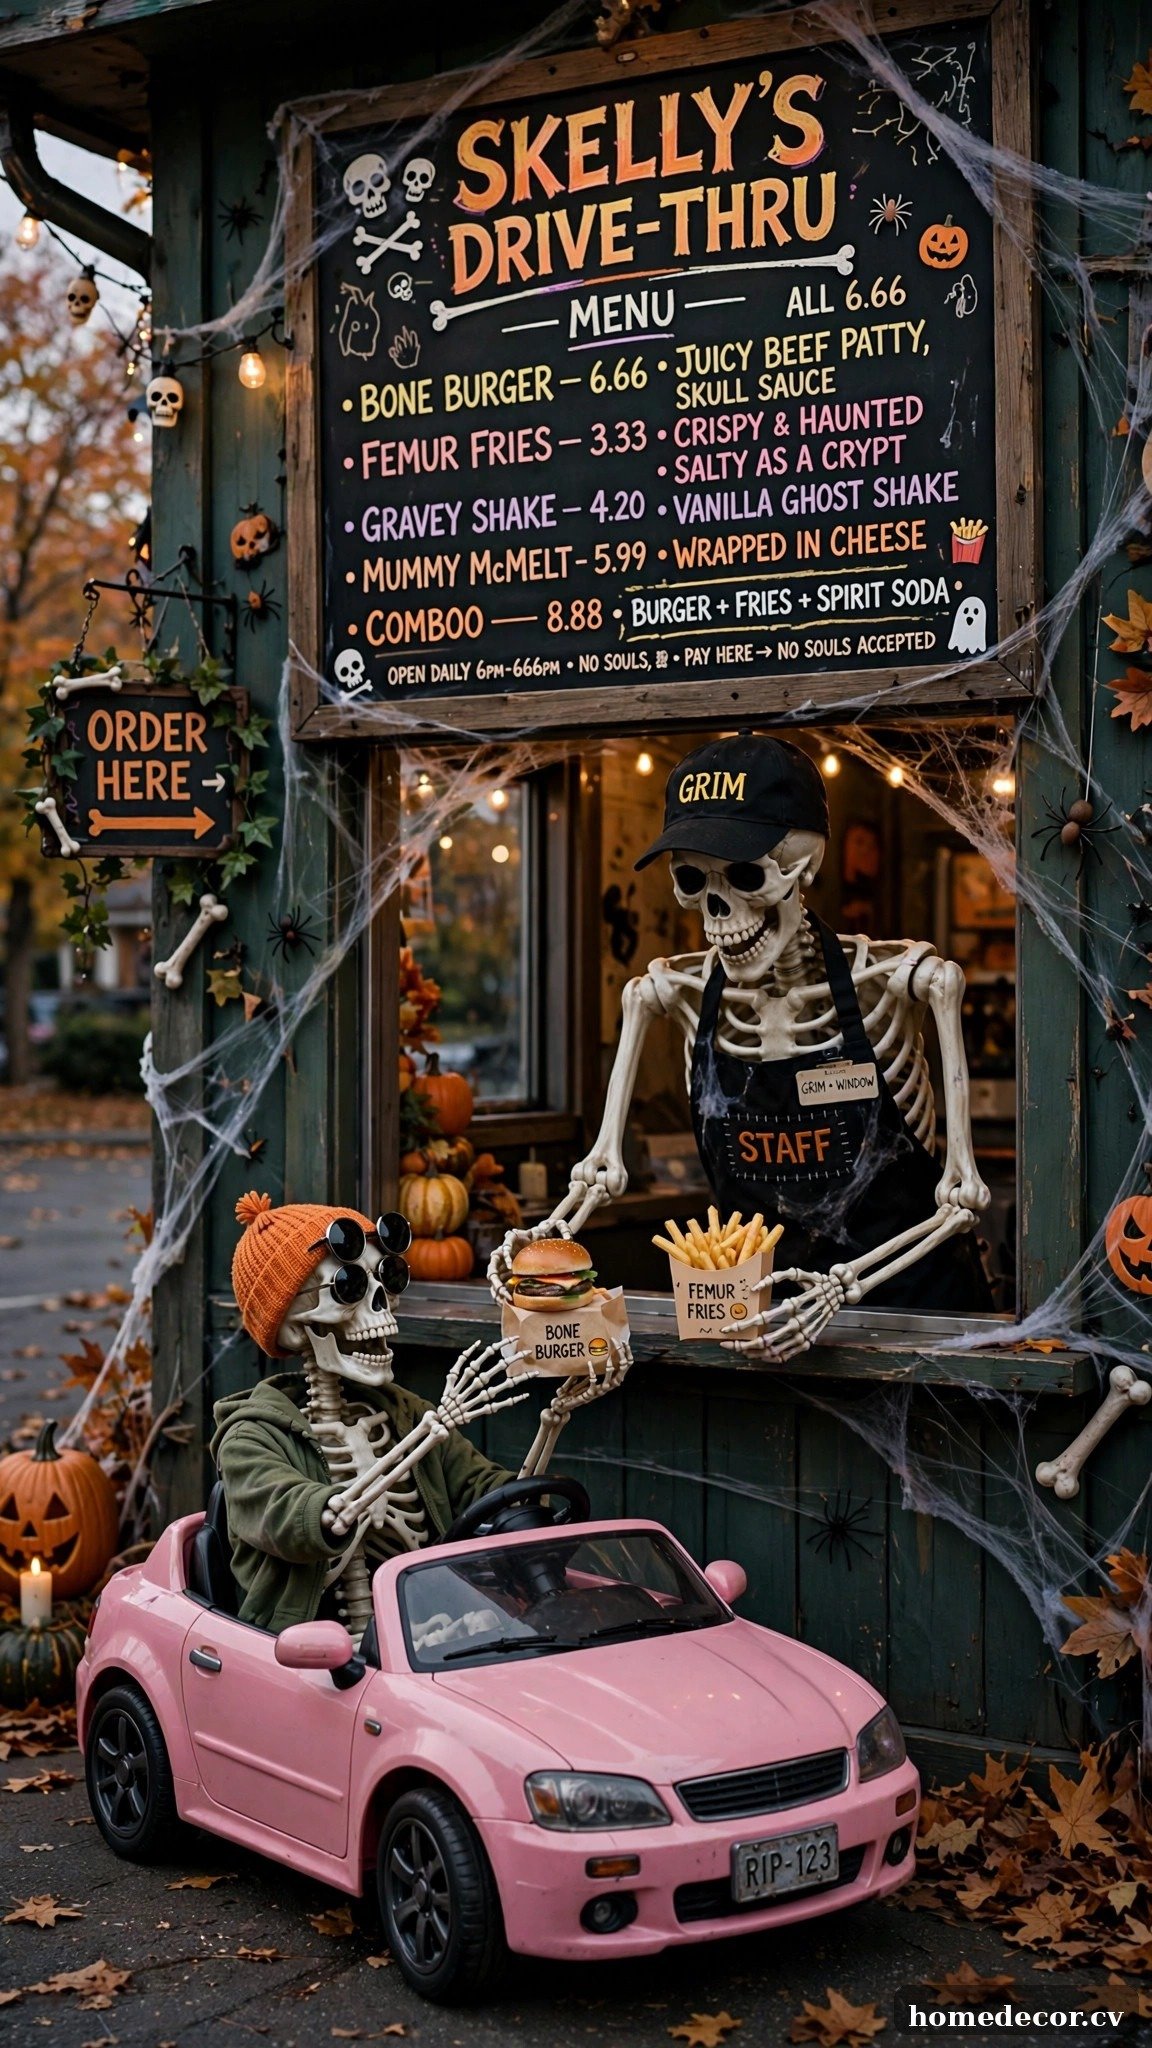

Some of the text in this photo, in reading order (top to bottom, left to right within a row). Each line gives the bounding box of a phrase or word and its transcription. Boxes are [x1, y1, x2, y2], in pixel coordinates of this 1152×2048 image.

[453, 71, 824, 214] SKELLY'S
[448, 171, 837, 295] DRIVE-THRU
[570, 289, 674, 338] MENU
[786, 275, 906, 317] ALL 6.66
[676, 319, 929, 377] JUICY BEEF PATTY,
[361, 356, 647, 422] BONE BURGER 6.66
[676, 367, 836, 409] SKULL SAUCE
[674, 396, 923, 447] CRISPY & HAUNTED
[362, 420, 647, 479] FEMUR FRIES 3.33
[675, 435, 906, 484] SALTY AS A CRYPT
[362, 490, 645, 542] GRAVEY SHAKE 4.20
[673, 471, 958, 524] VANILLA GHOST SHAKE
[364, 541, 646, 593] MUMMY McMELT 5.99
[673, 520, 926, 569] WRAPPED IN CHEESE
[366, 599, 602, 646] COMBOO 8.88
[631, 577, 950, 626] BURGER + FRIES + SPIRIT SODA
[388, 665, 425, 685] OPEN
[431, 662, 471, 682] DAILY
[579, 655, 599, 672] NO
[604, 651, 651, 671] SOULS,
[685, 647, 710, 666] PAY
[717, 644, 753, 663] HERE
[778, 641, 799, 659] NO
[805, 637, 851, 658] SOULS
[857, 631, 936, 654] ACCEPTED
[88, 710, 207, 753] ORDER
[98, 760, 190, 800] HERE
[679, 772, 747, 803] GRIM
[802, 1076, 874, 1094] GRIM WINDOW
[739, 1128, 830, 1163] STAFF
[688, 1303, 725, 1319] FRIES
[689, 1283, 735, 1299] FEMUR
[536, 1342, 585, 1360] BURGER
[546, 1323, 580, 1340] BONE
[745, 1841, 831, 1887] RIP-123
